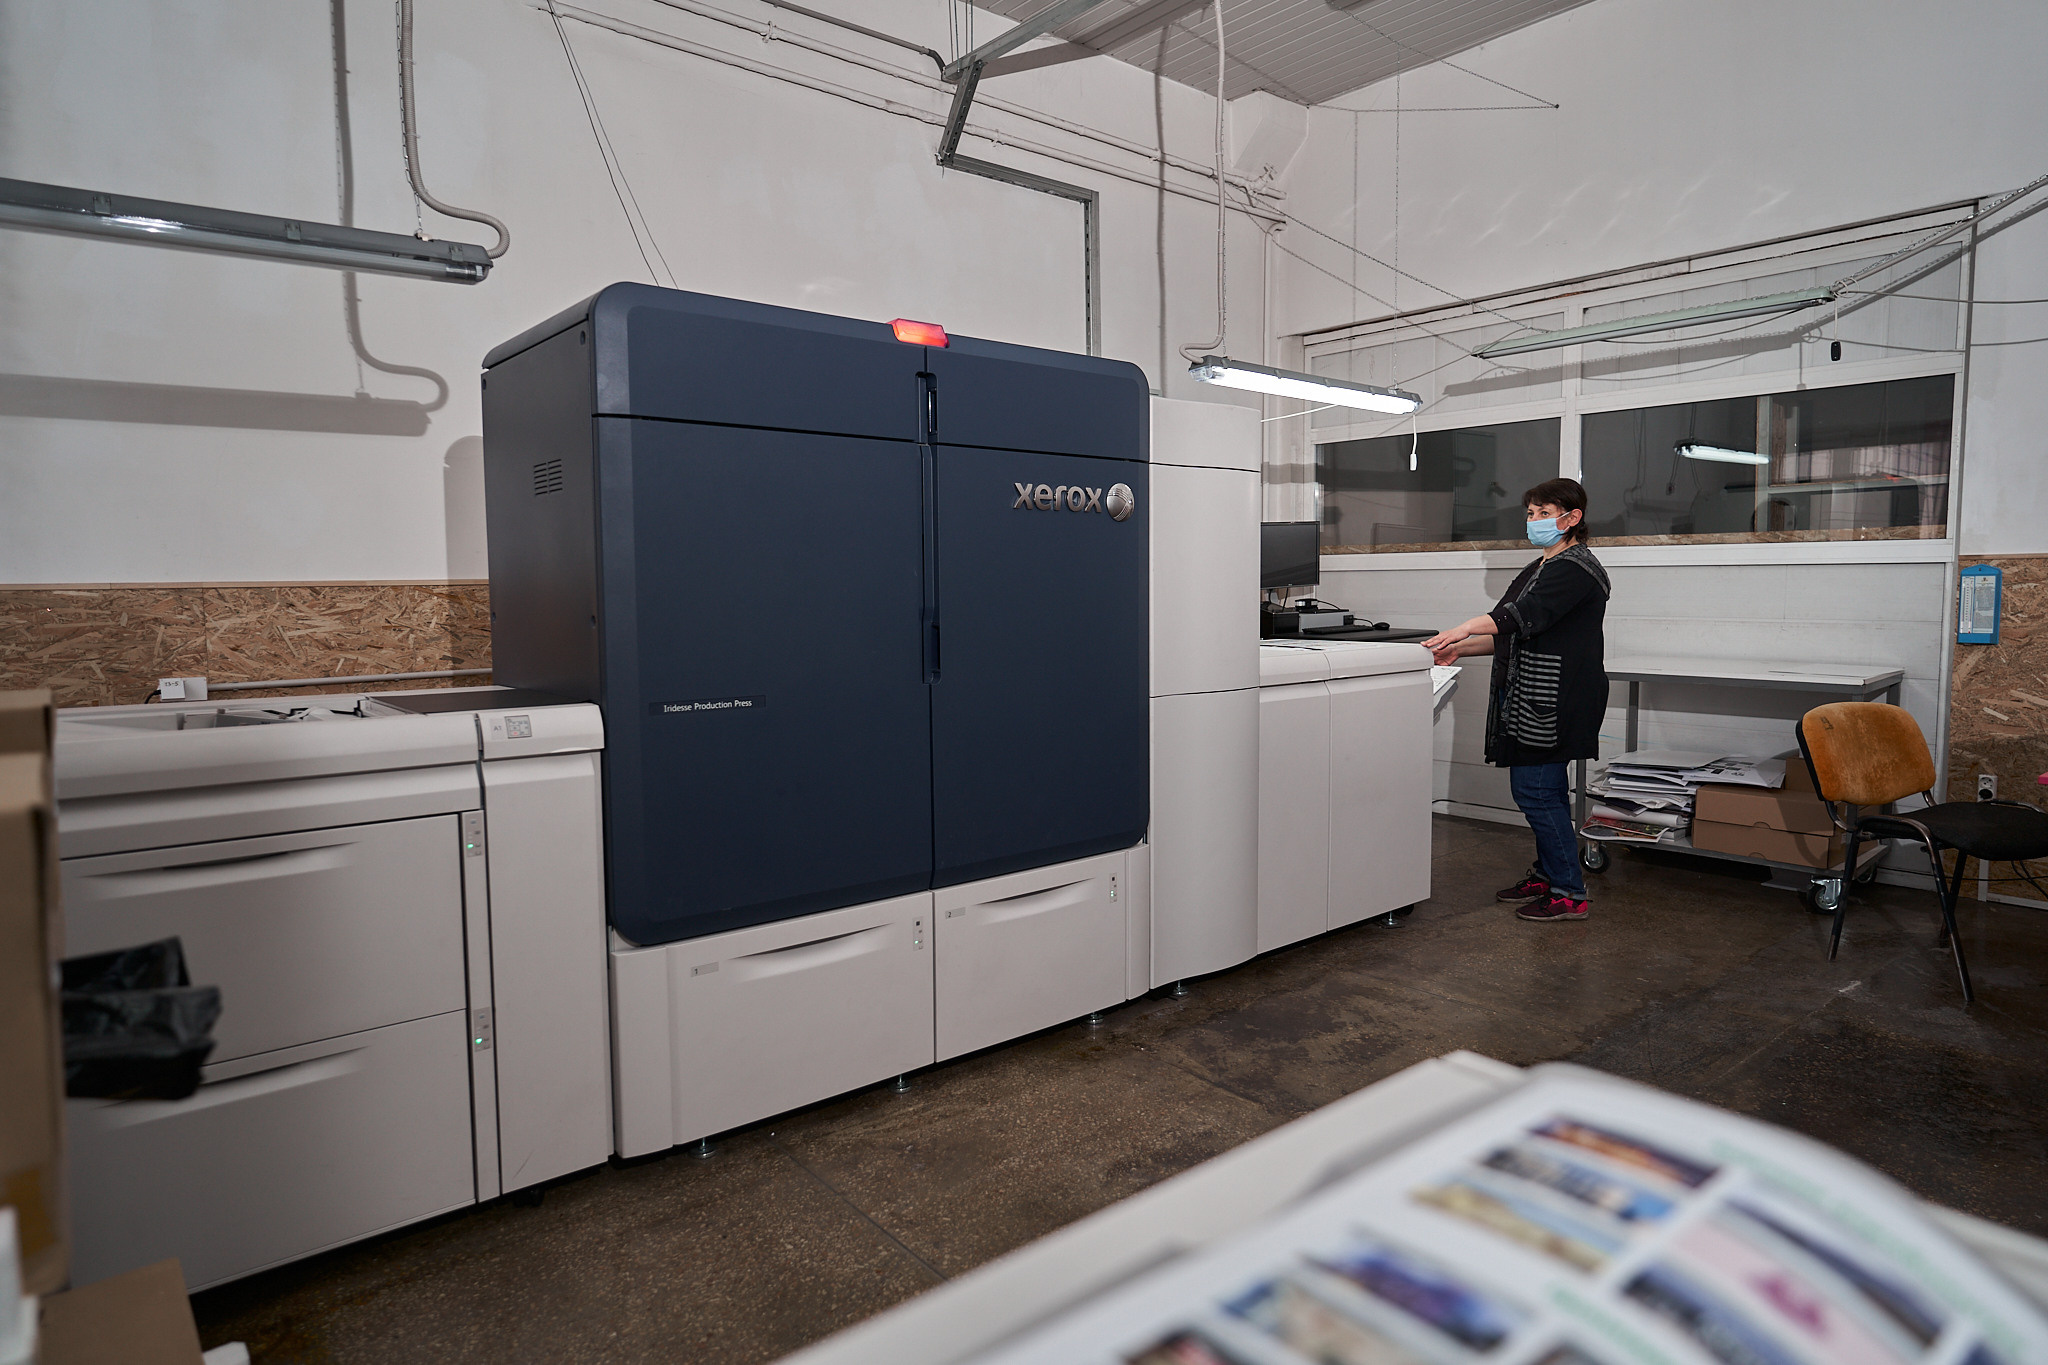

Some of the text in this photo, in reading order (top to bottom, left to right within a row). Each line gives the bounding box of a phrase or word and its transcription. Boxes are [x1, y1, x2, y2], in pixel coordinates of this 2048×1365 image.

[1013, 482, 1102, 513] xerox
[663, 699, 753, 713] Iridesse Production Press
